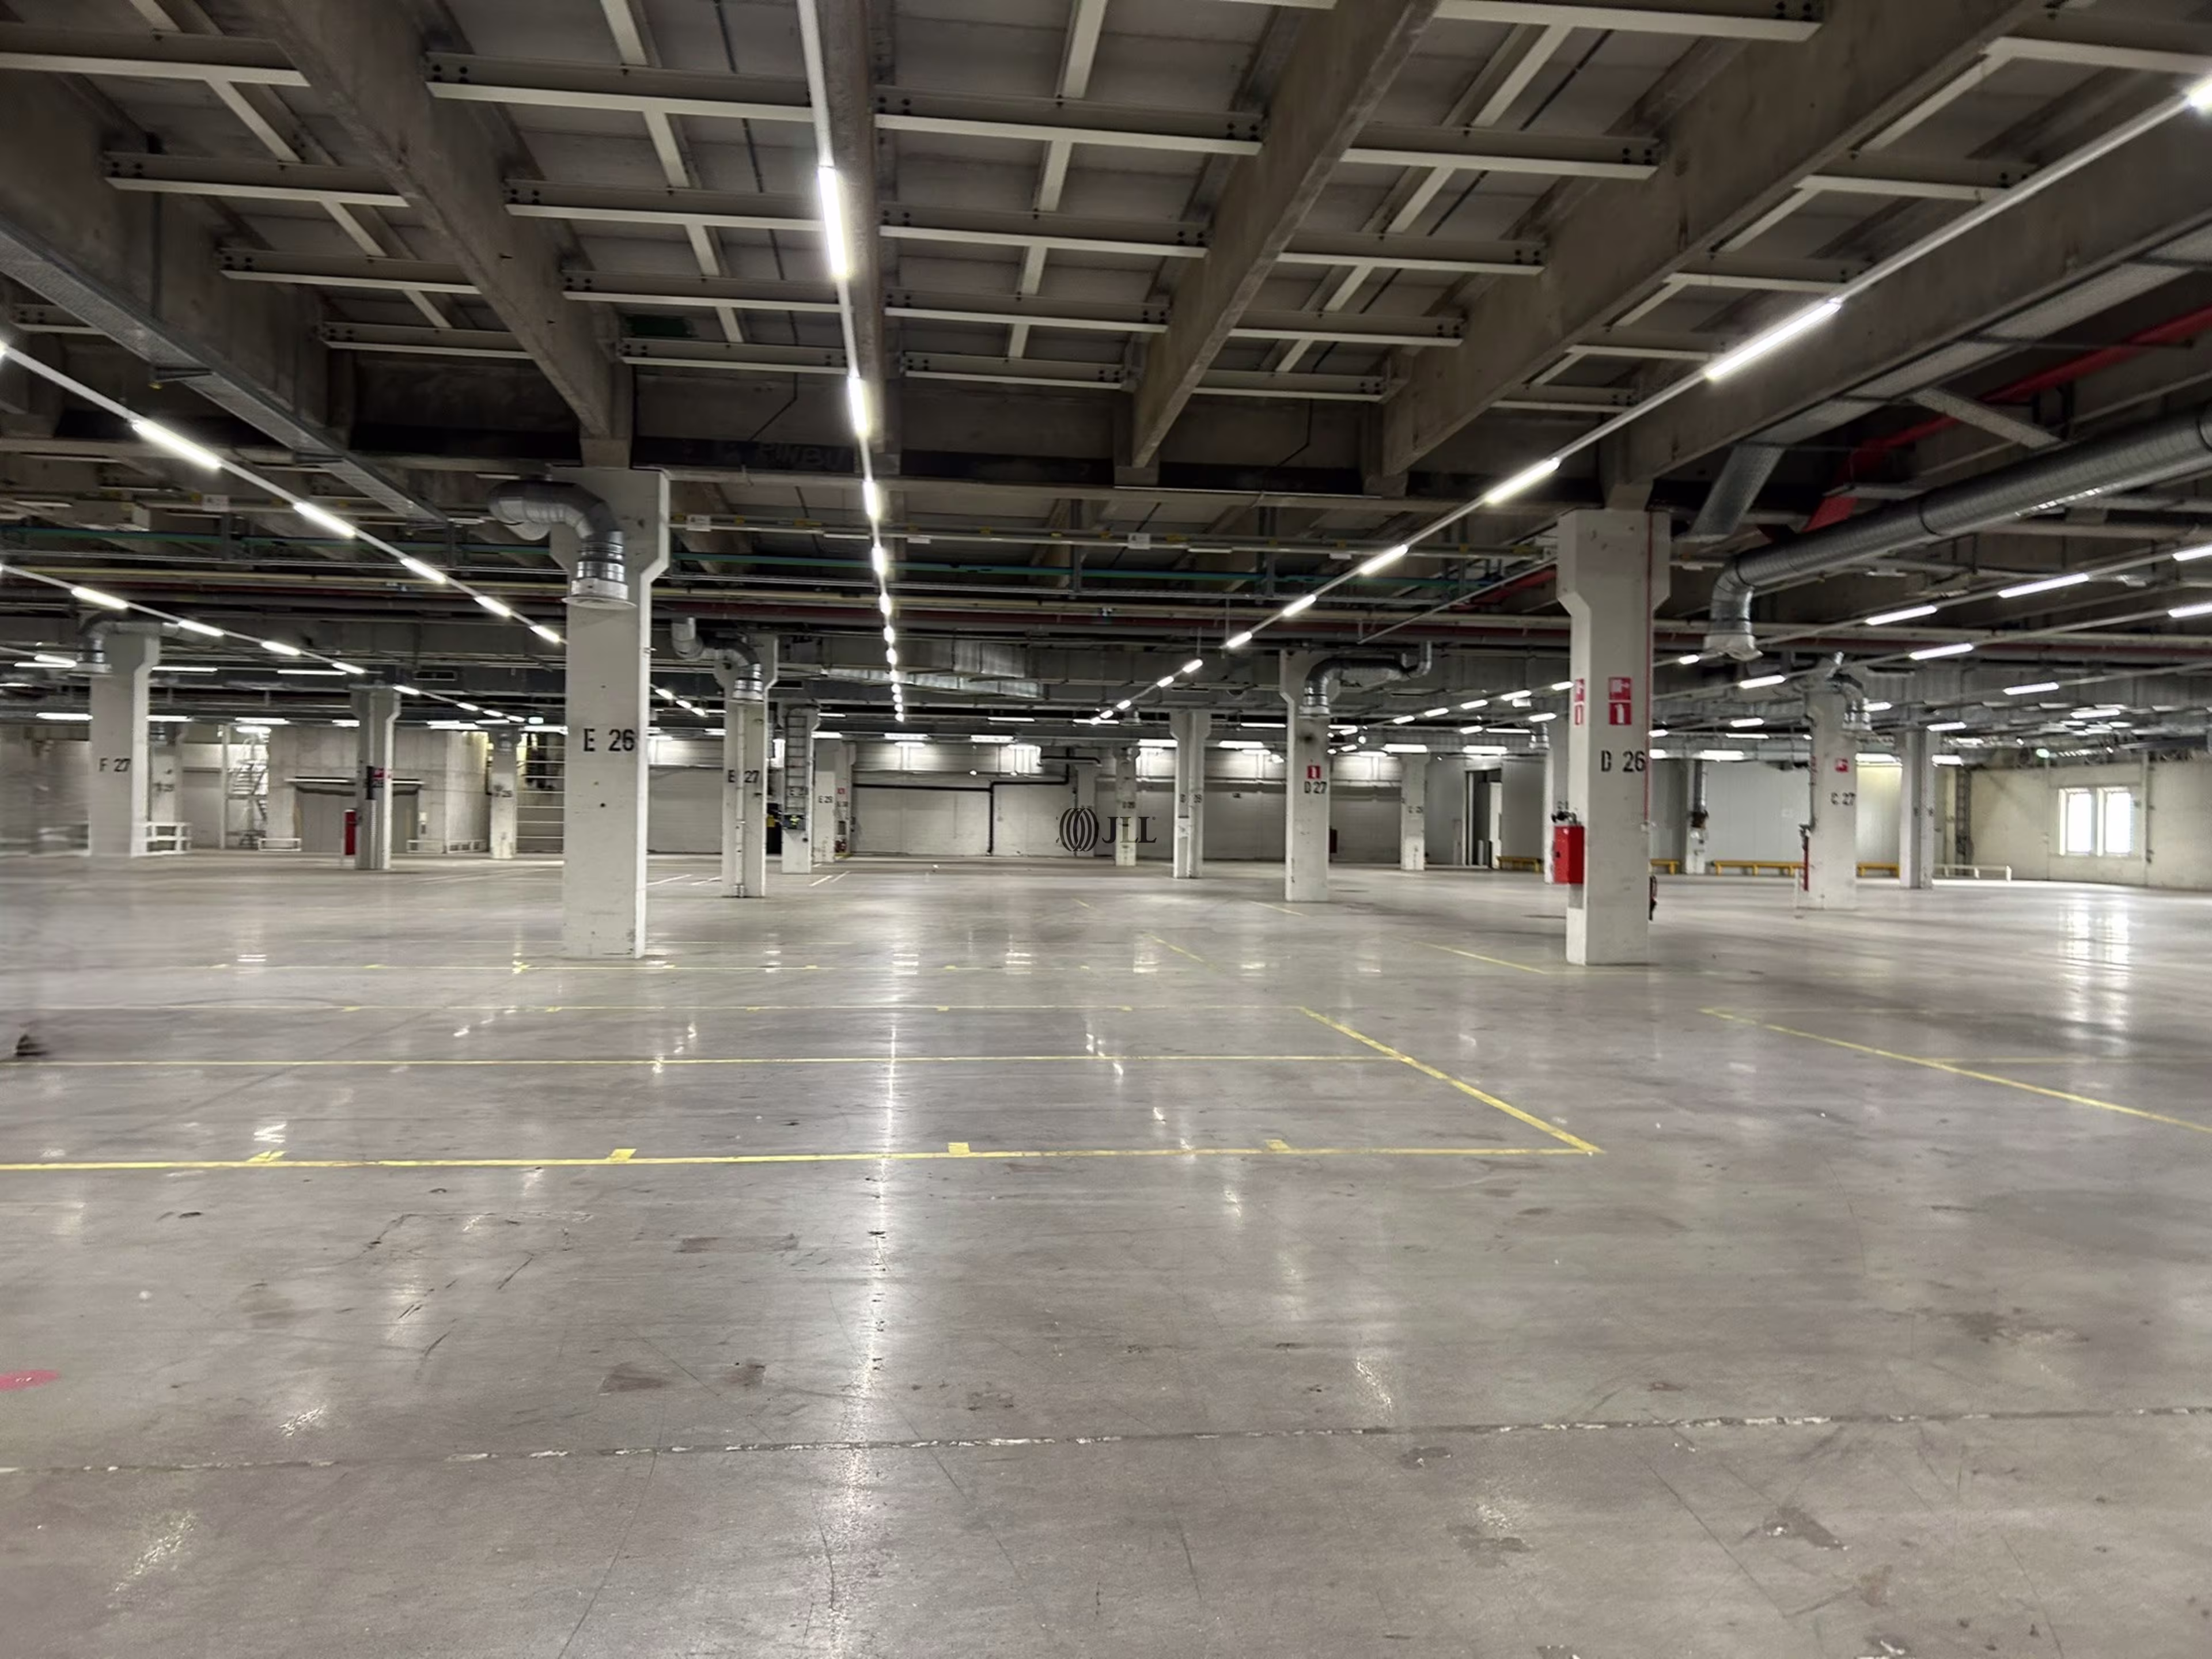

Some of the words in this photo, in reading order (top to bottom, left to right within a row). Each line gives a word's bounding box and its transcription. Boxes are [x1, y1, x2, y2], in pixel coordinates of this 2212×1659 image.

[584, 728, 595, 752] E
[608, 729, 635, 752] 26
[100, 757, 108, 772] F
[113, 757, 131, 772] 27
[1601, 750, 1611, 772] D
[1623, 751, 1646, 772] 26
[728, 770, 735, 783] E
[744, 770, 760, 783] 27
[1304, 781, 1311, 793] D
[1313, 781, 1327, 794] 27
[1842, 792, 1855, 806] 27
